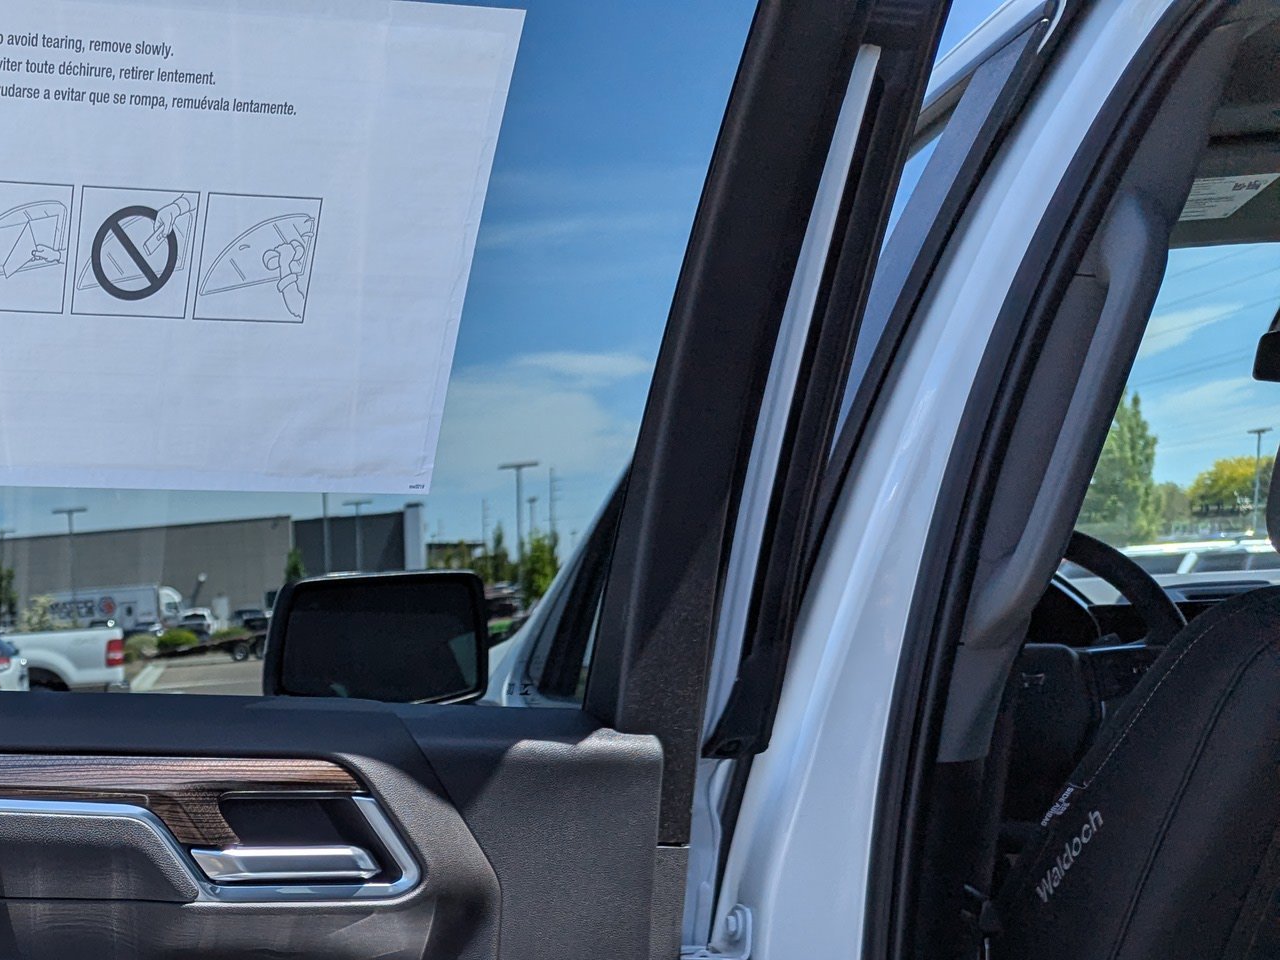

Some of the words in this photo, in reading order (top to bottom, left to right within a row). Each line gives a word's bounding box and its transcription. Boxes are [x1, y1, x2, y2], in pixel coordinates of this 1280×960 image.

[7, 33, 38, 47] avoid
[42, 34, 85, 53] tearing,
[89, 40, 132, 54] remove
[135, 41, 174, 59] slowly.
[26, 59, 55, 74] toute
[58, 61, 116, 80] déchirure,
[119, 66, 154, 81] retirer
[157, 68, 216, 85] lentement.
[43, 89, 51, 100] a
[54, 88, 86, 102] evitar
[89, 92, 110, 106] que
[113, 93, 126, 105] se
[129, 94, 168, 110] rompa,
[172, 96, 230, 111] remuévala
[233, 99, 297, 116] lentamente.
[1036, 810, 1104, 902] Waldoch
